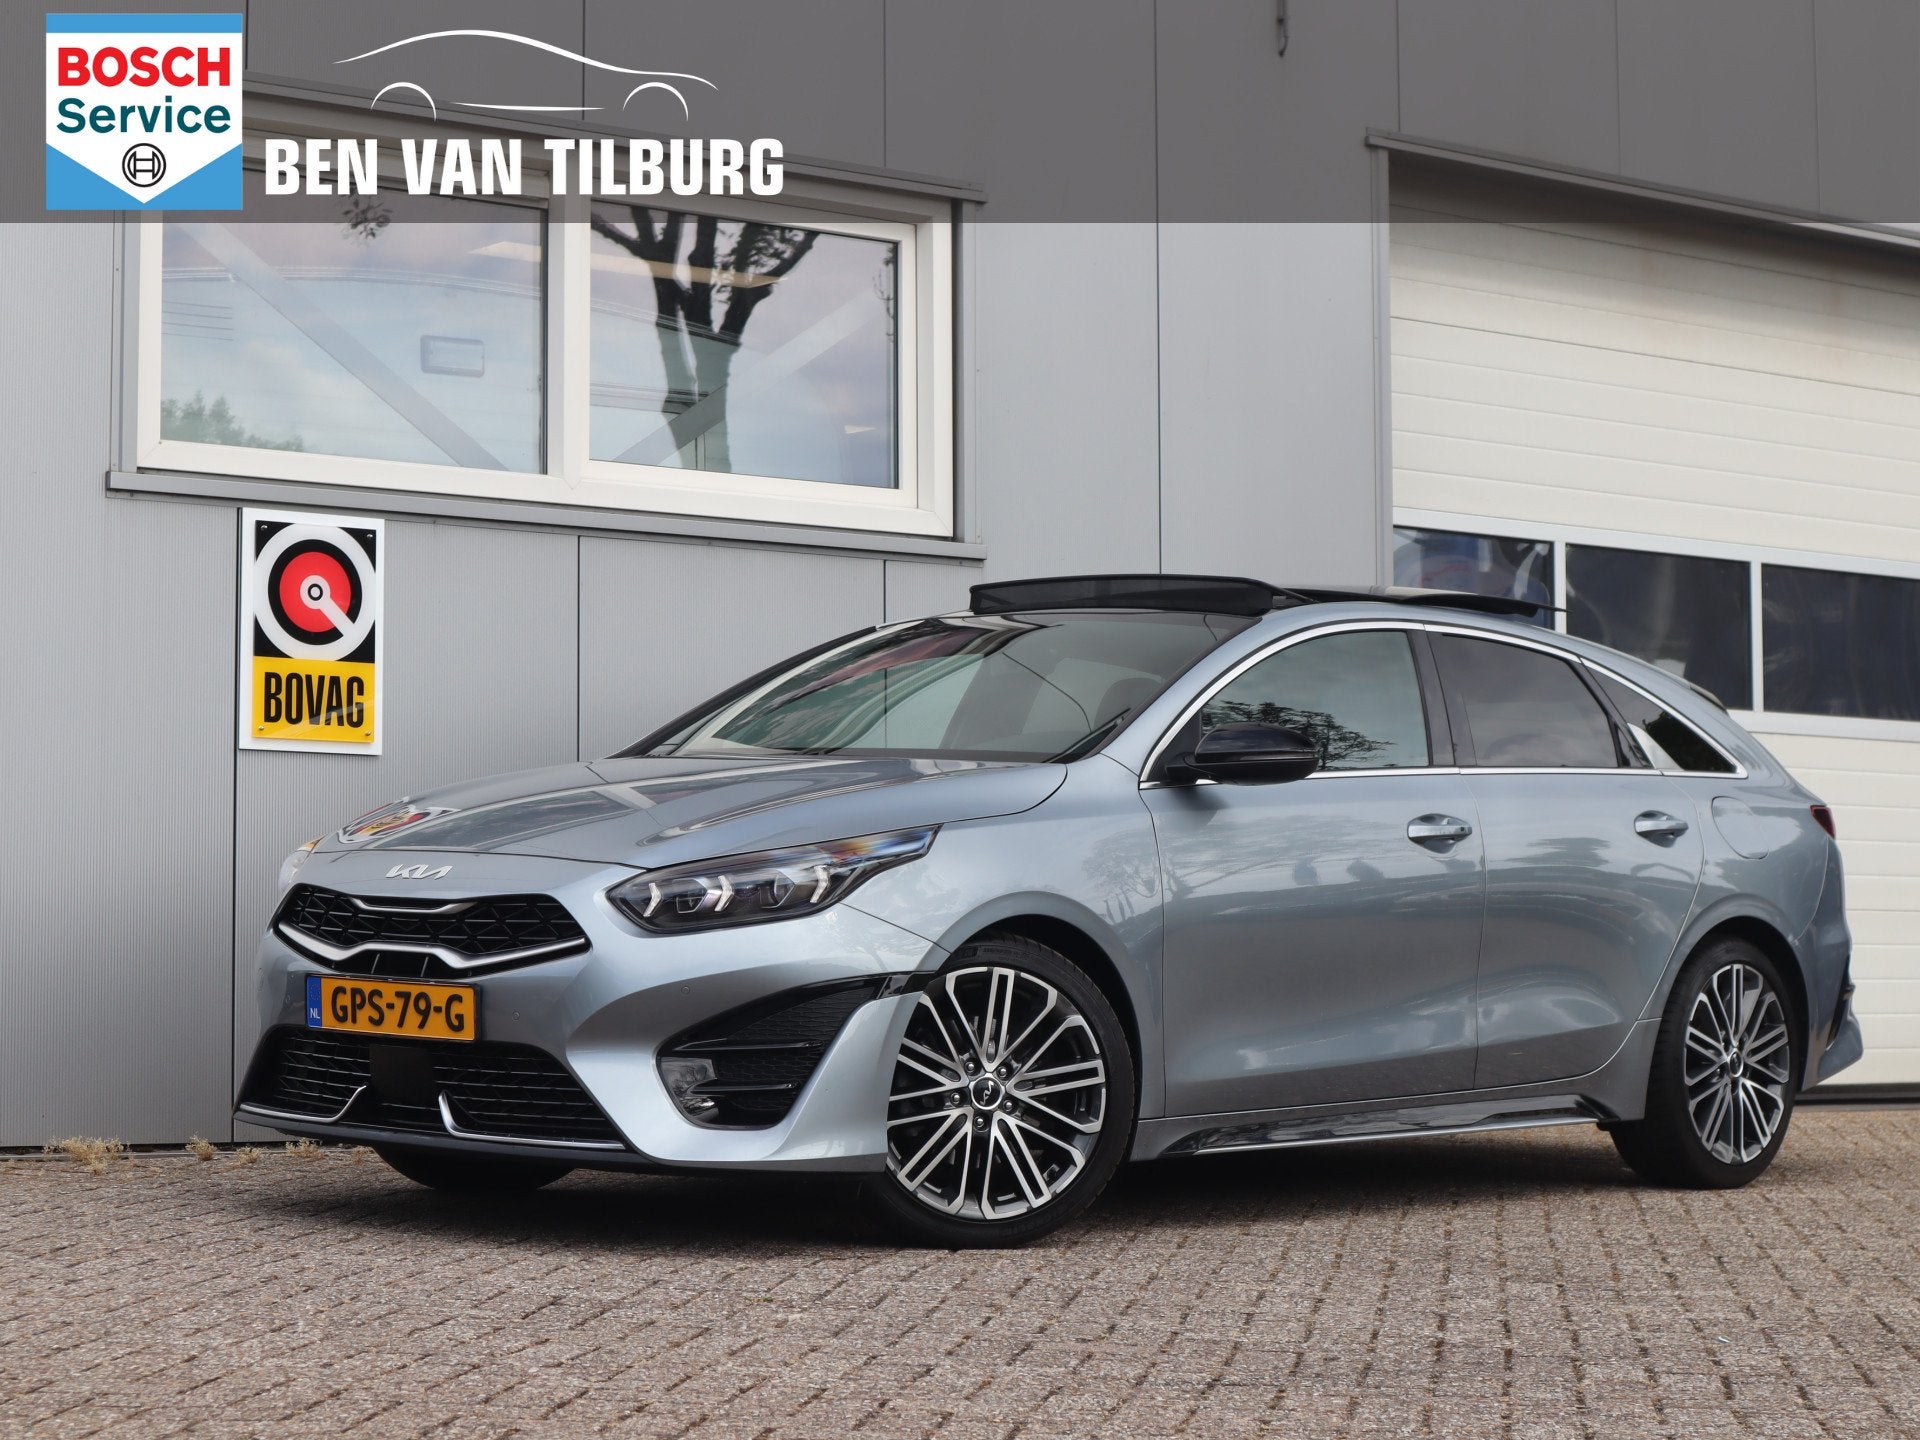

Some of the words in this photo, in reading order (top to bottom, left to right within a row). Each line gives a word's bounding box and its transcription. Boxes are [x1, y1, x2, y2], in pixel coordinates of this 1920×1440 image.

[264, 671, 364, 728] BOVAG
[310, 1007, 321, 1019] NL
[331, 985, 465, 1032] GPS-79-G
